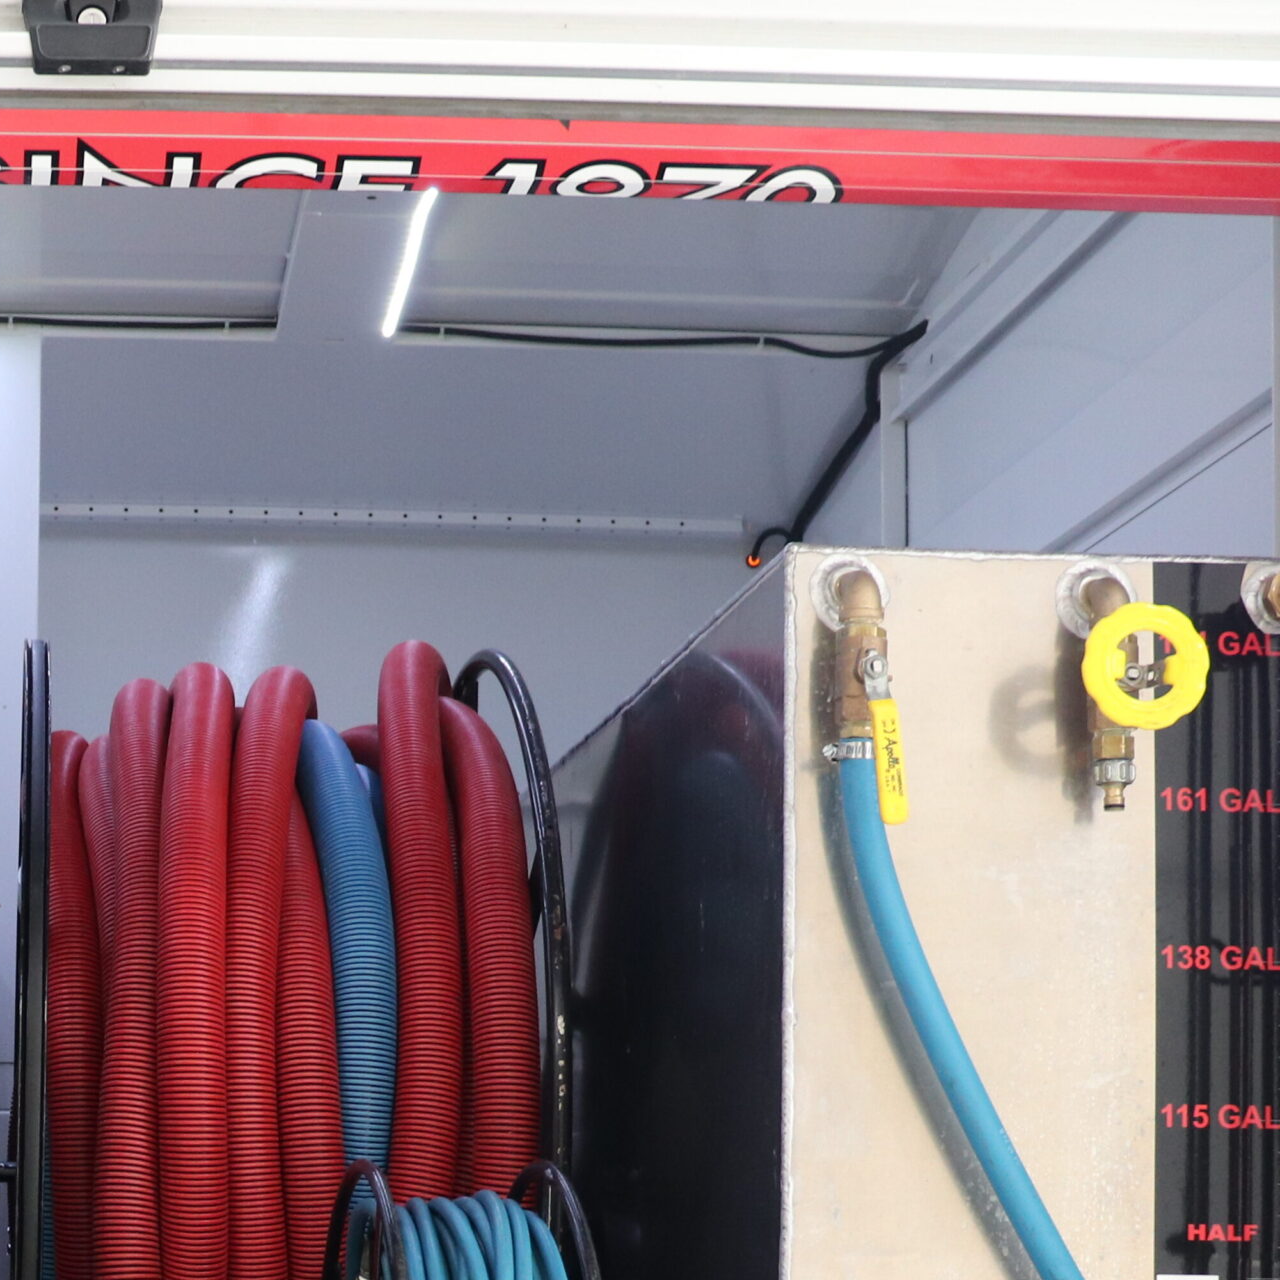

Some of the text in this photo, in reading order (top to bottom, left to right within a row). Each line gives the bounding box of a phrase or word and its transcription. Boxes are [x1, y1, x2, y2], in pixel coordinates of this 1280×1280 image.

[881, 737, 901, 770] Apollo
[1160, 787, 1207, 812] 161
[1160, 944, 1212, 970] 138
[1160, 1103, 1210, 1129] 115
[1187, 1223, 1259, 1242] HALF
